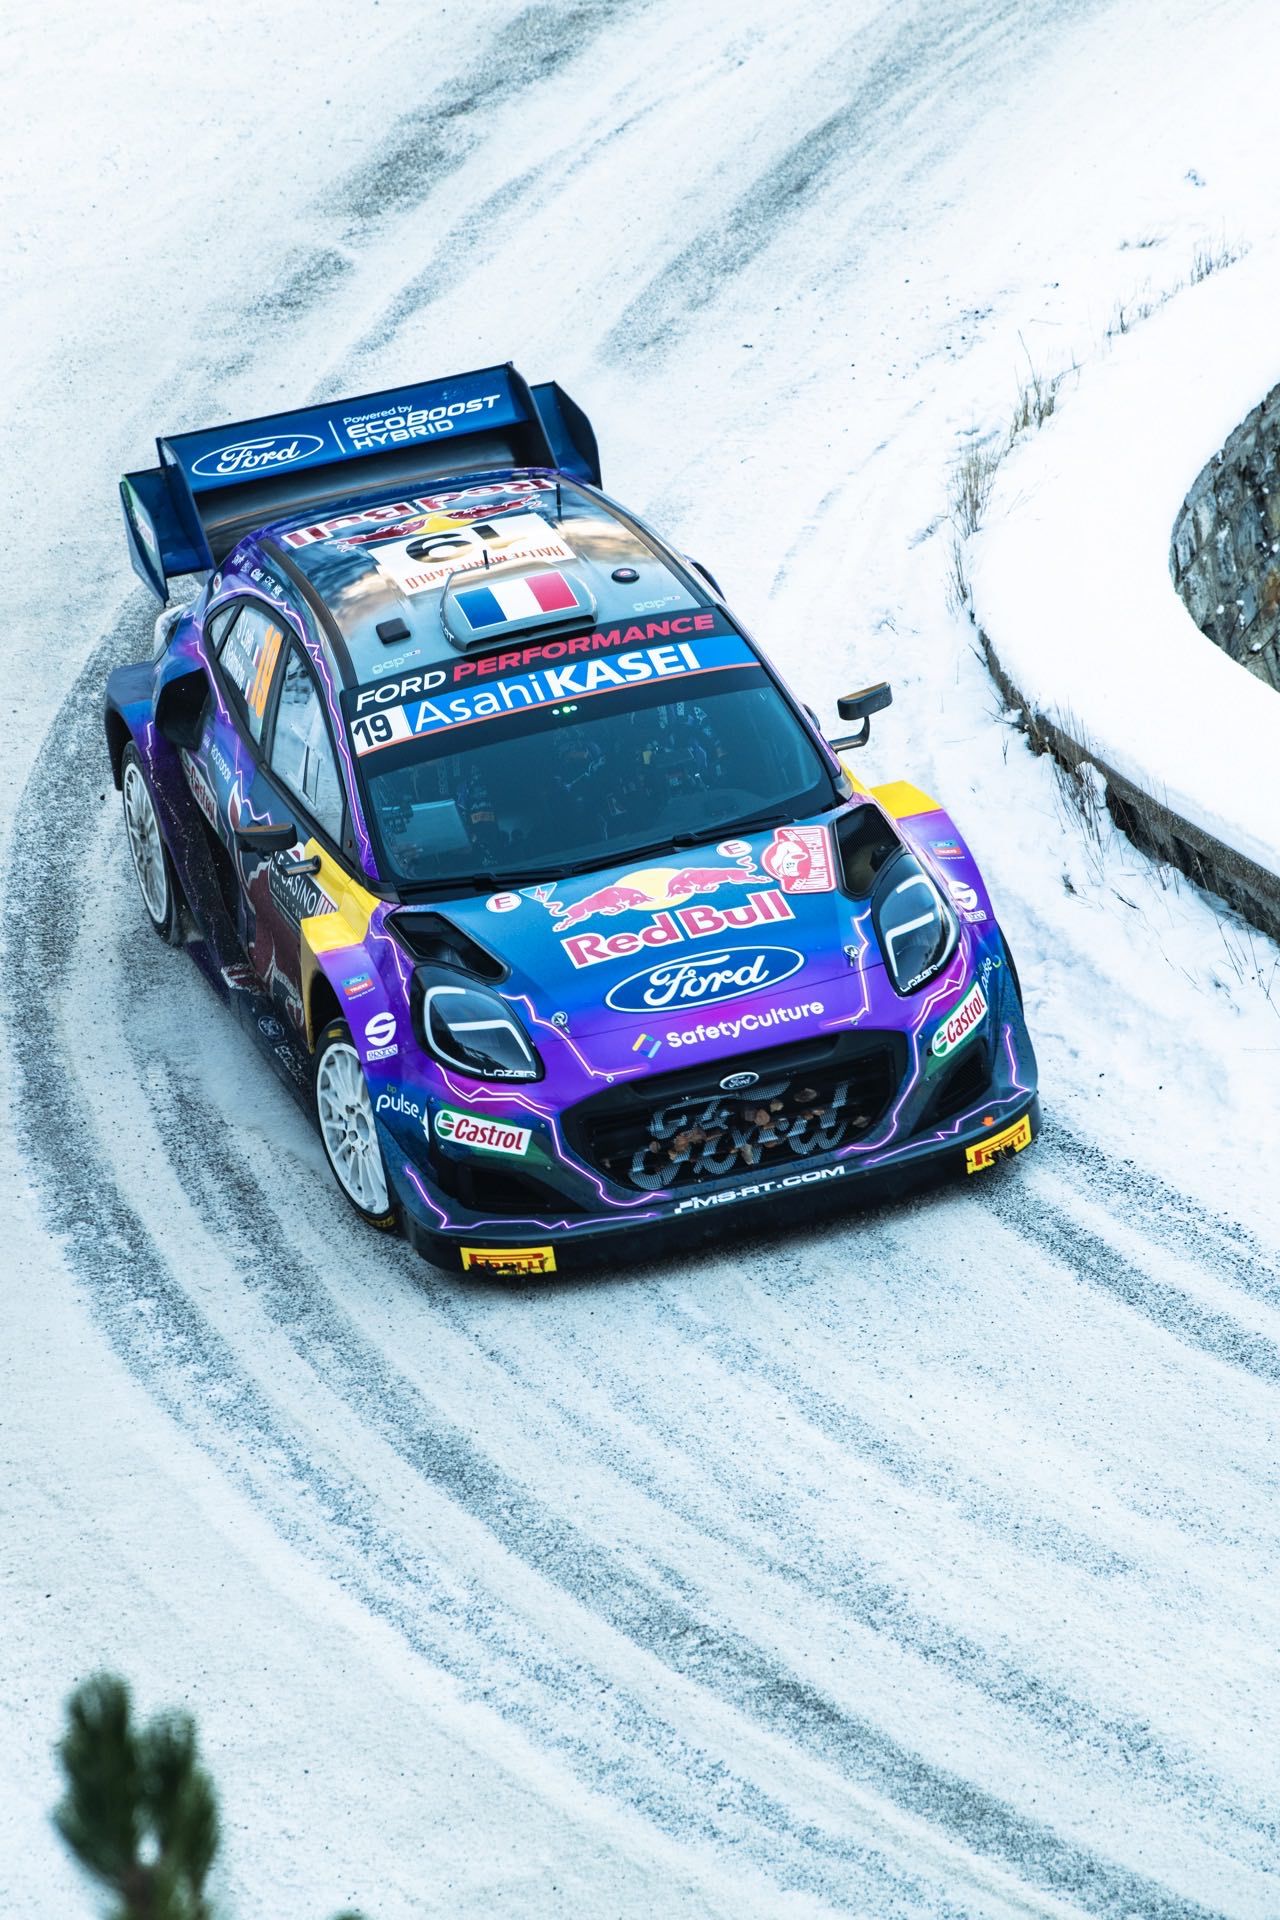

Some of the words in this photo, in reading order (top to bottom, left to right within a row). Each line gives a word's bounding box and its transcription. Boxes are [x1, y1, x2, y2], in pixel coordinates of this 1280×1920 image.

[343, 407, 395, 426] Powered
[398, 404, 413, 416] by
[346, 394, 501, 439] ECOBOOST
[352, 421, 455, 450] HYBRID
[216, 440, 300, 473] Ford
[414, 478, 556, 512] Red
[281, 502, 419, 549] Bull
[356, 670, 447, 712] FORD
[453, 614, 715, 682] PERFORMANCE
[414, 643, 702, 733] AsahiKASEI
[353, 714, 394, 747] 19
[724, 842, 742, 854] E
[494, 896, 513, 909] E
[560, 915, 685, 969] Red
[676, 888, 796, 939] Bull
[643, 954, 772, 1006] Ford
[666, 1001, 825, 1048] SafetyCulture
[946, 989, 985, 1043] Castrol
[375, 1093, 419, 1118] pulse
[454, 1117, 524, 1151] Castrol
